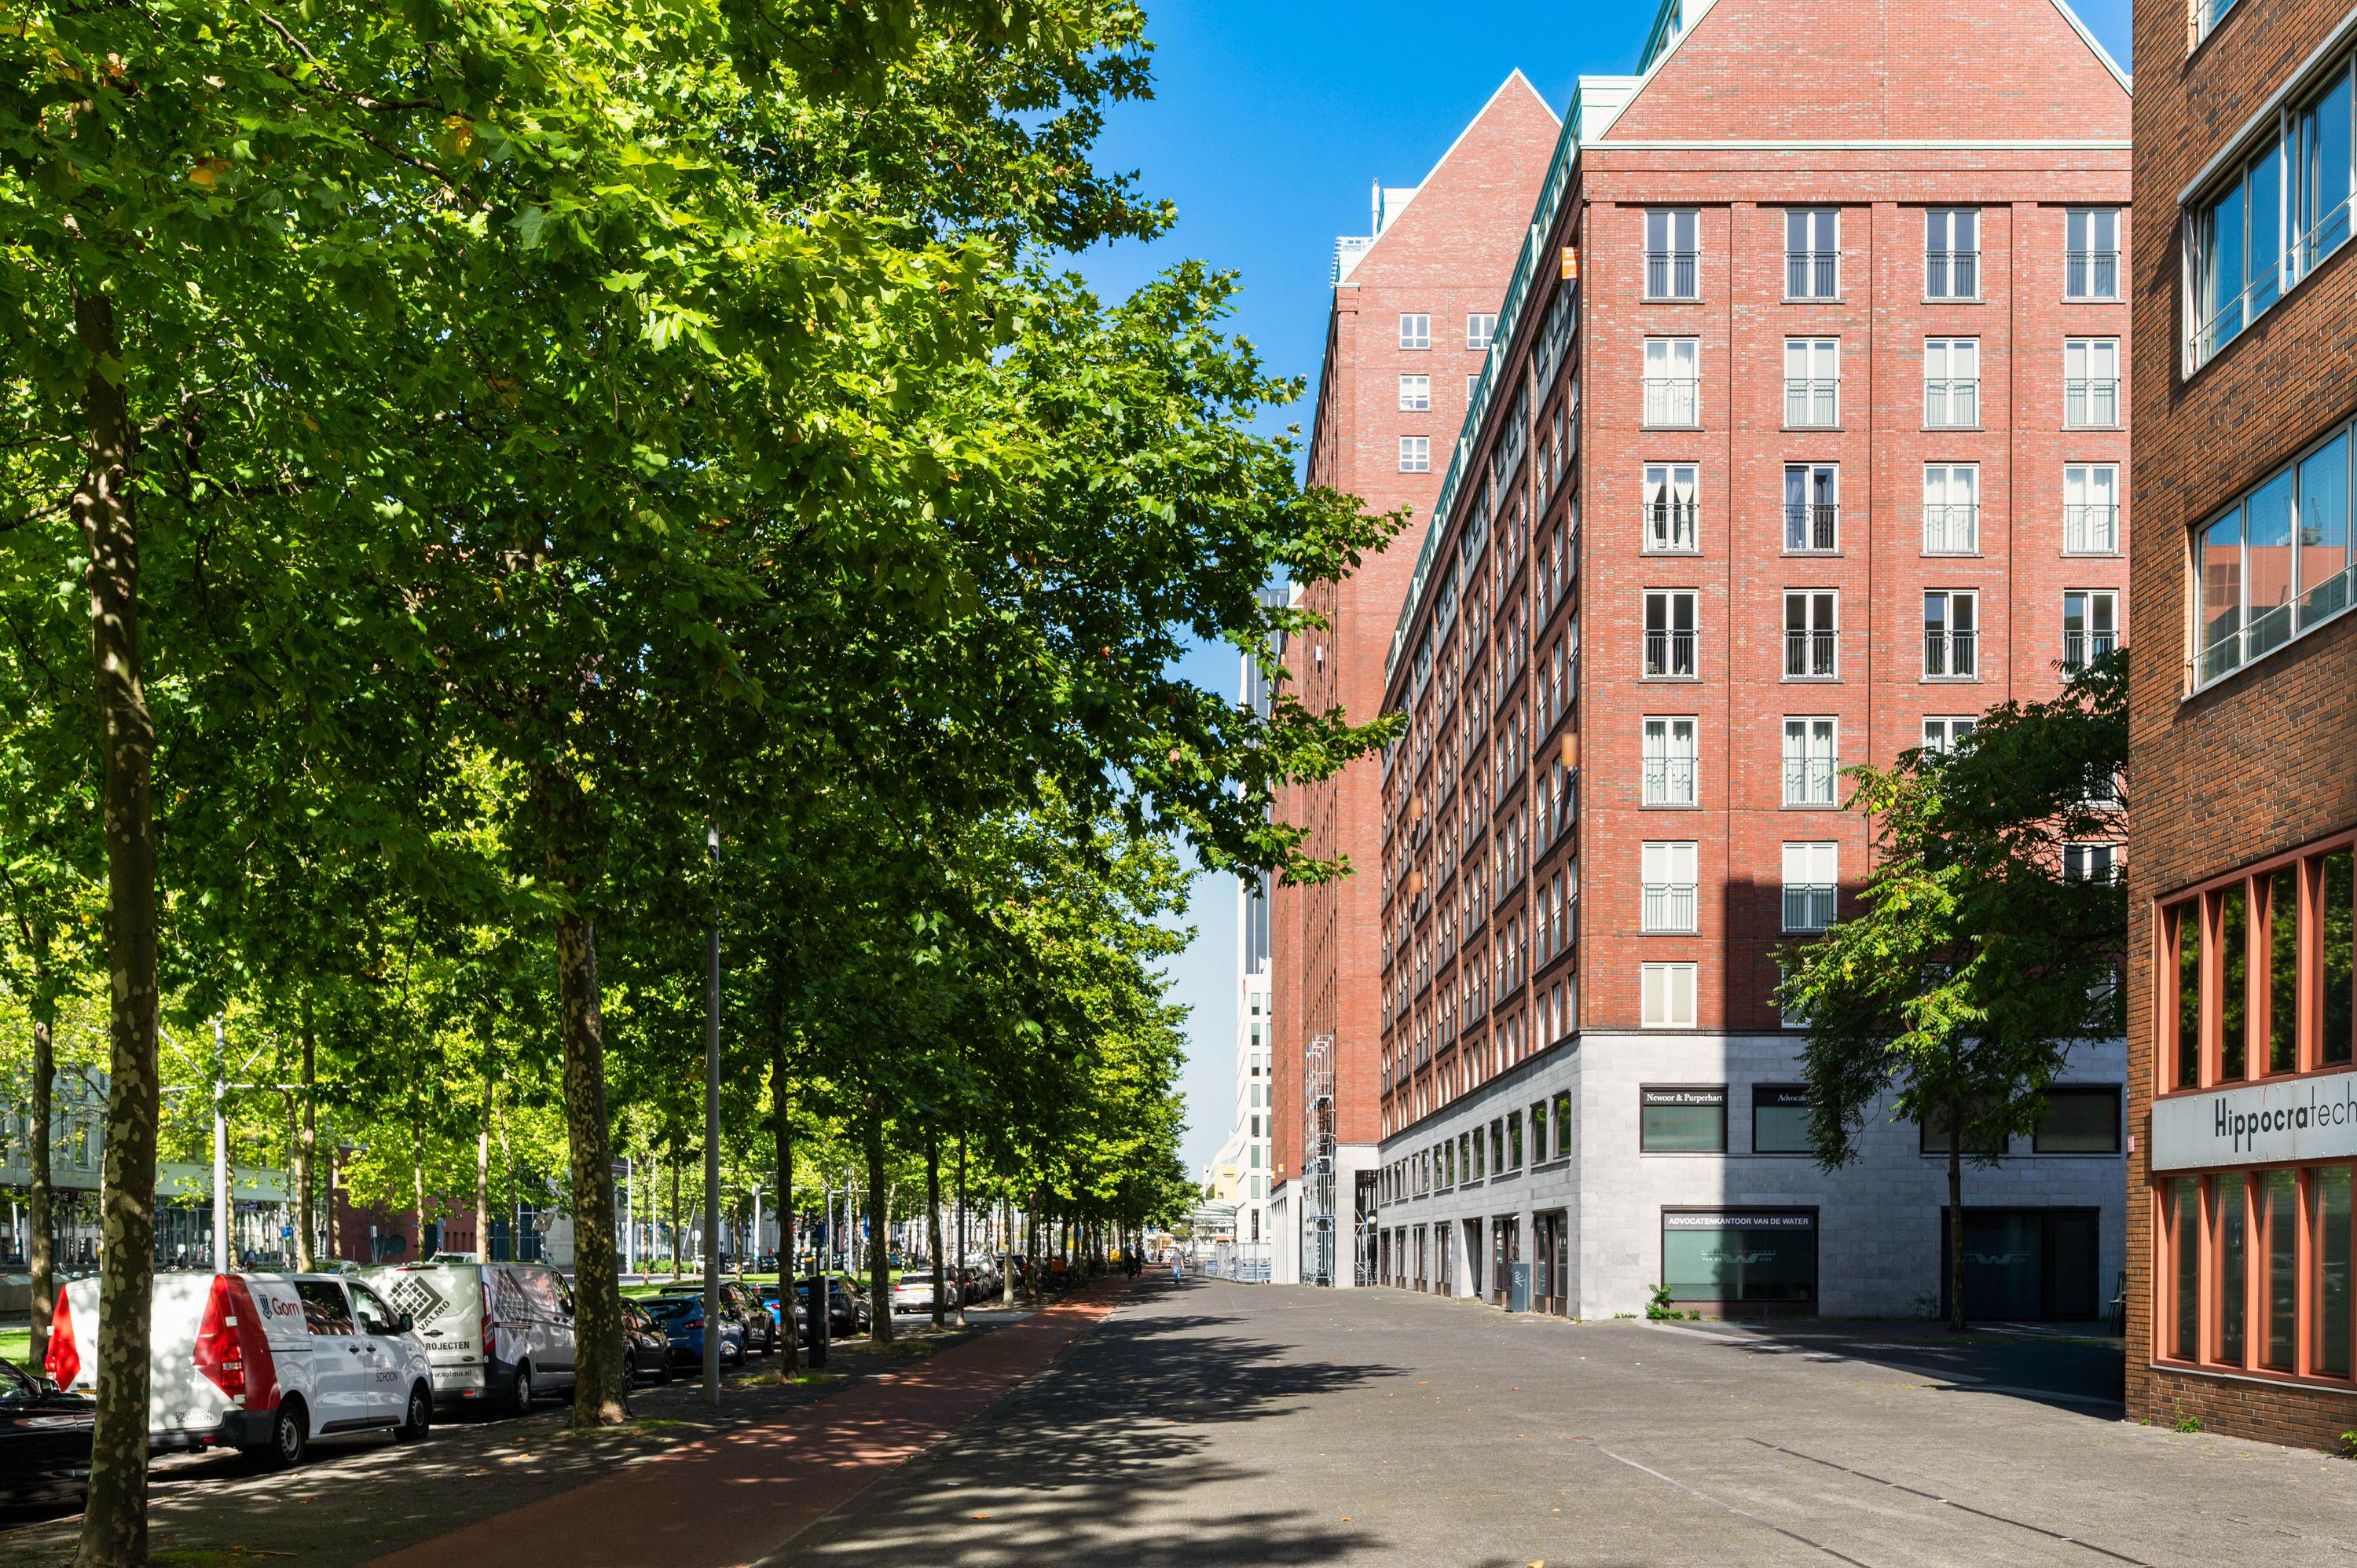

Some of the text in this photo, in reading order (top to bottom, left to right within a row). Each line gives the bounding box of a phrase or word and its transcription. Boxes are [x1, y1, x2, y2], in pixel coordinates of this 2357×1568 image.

[1647, 1093, 1675, 1101] Newoor
[1684, 1093, 1722, 1104] Purperhart
[2215, 1080, 2357, 1153] Hippocratech
[272, 1297, 299, 1316] Gom
[418, 1300, 450, 1332] VALMO
[423, 1341, 470, 1350] ROJECTEN
[376, 1371, 398, 1383] SCHOON
